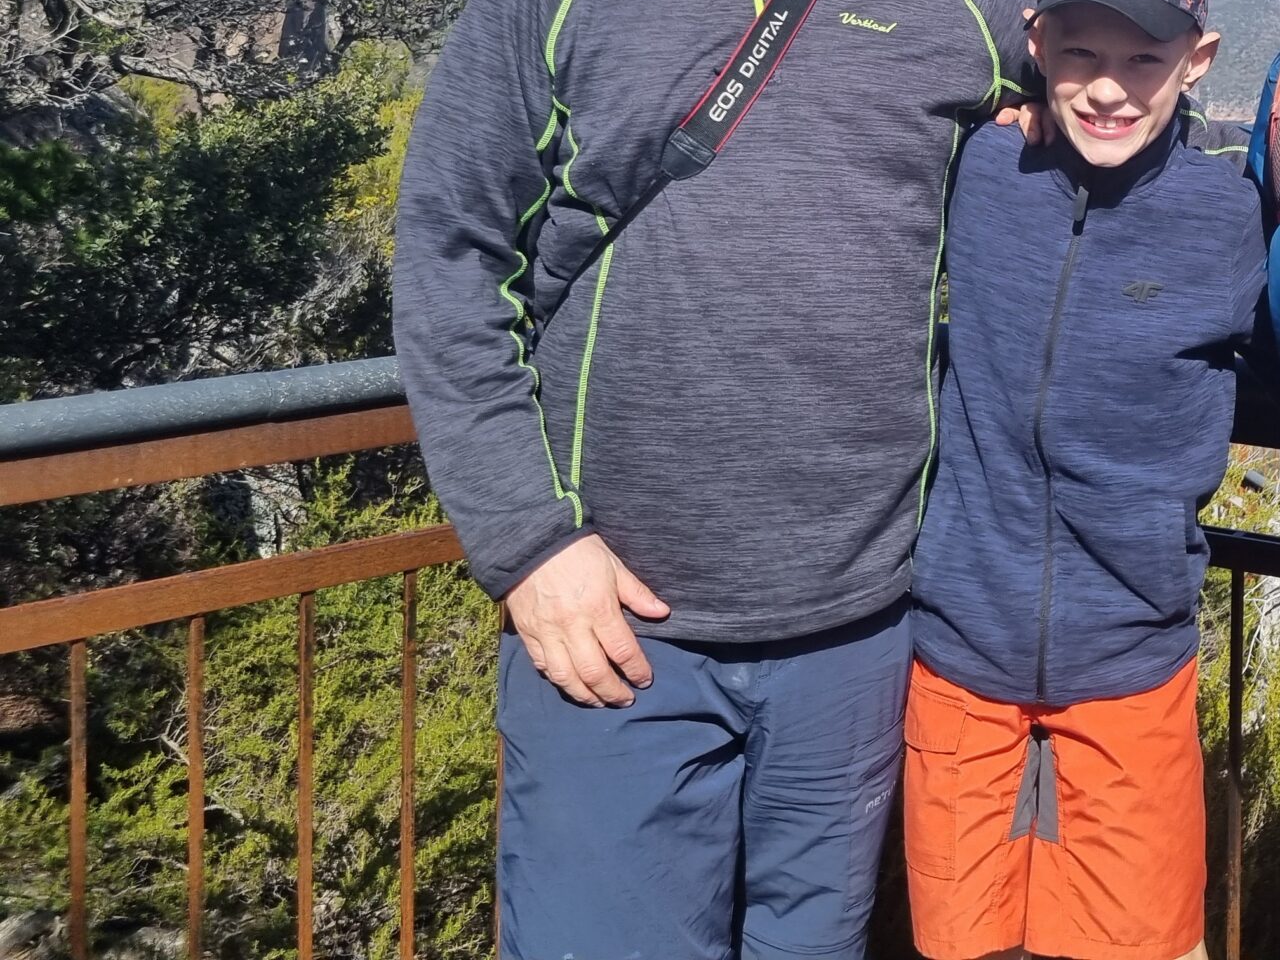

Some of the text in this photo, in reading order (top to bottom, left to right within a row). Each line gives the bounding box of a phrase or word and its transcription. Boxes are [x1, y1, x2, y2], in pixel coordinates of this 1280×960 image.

[839, 12, 898, 33] Vertical
[709, 10, 789, 122] EOS DIGITAL
